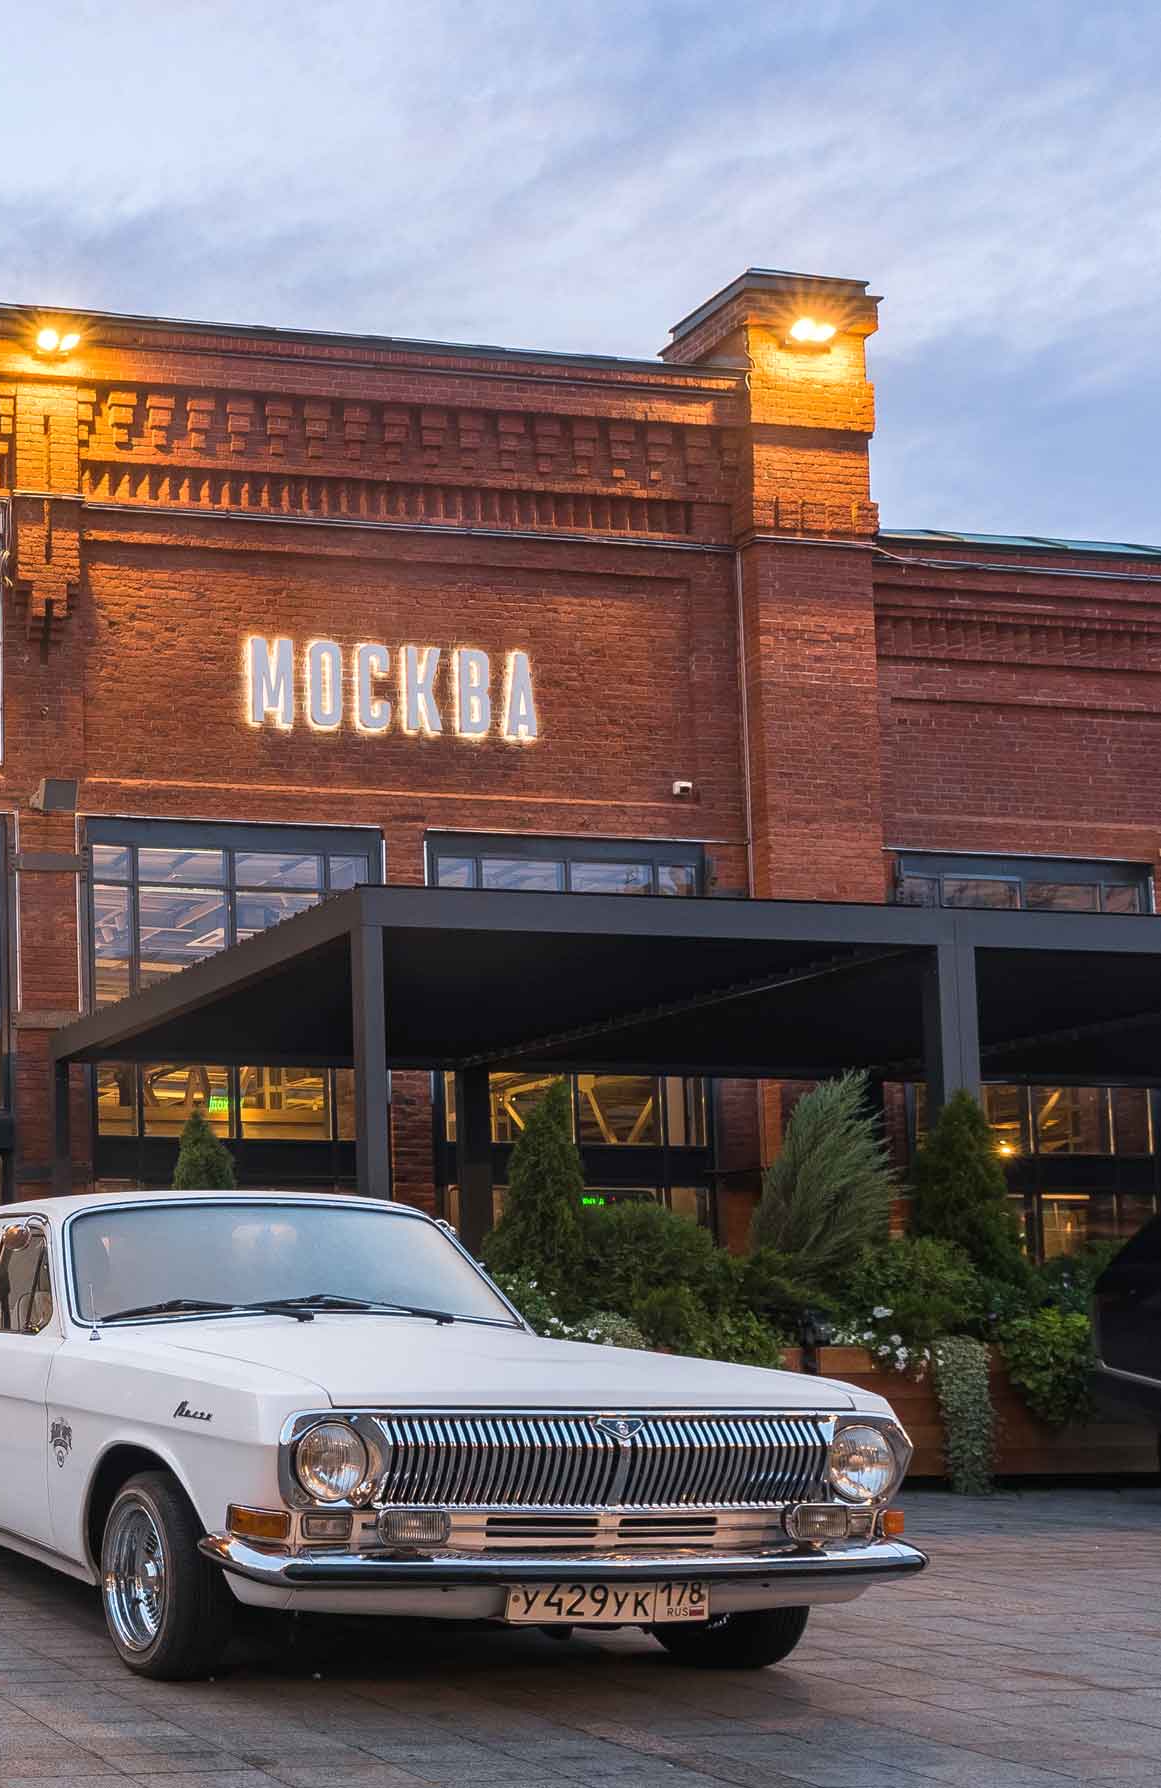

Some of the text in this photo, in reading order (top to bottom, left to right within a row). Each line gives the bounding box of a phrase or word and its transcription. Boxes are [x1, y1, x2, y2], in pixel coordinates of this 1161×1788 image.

[249, 638, 538, 738] МОСКВА
[660, 1582, 703, 1606] 178
[667, 1607, 689, 1617] RUS
